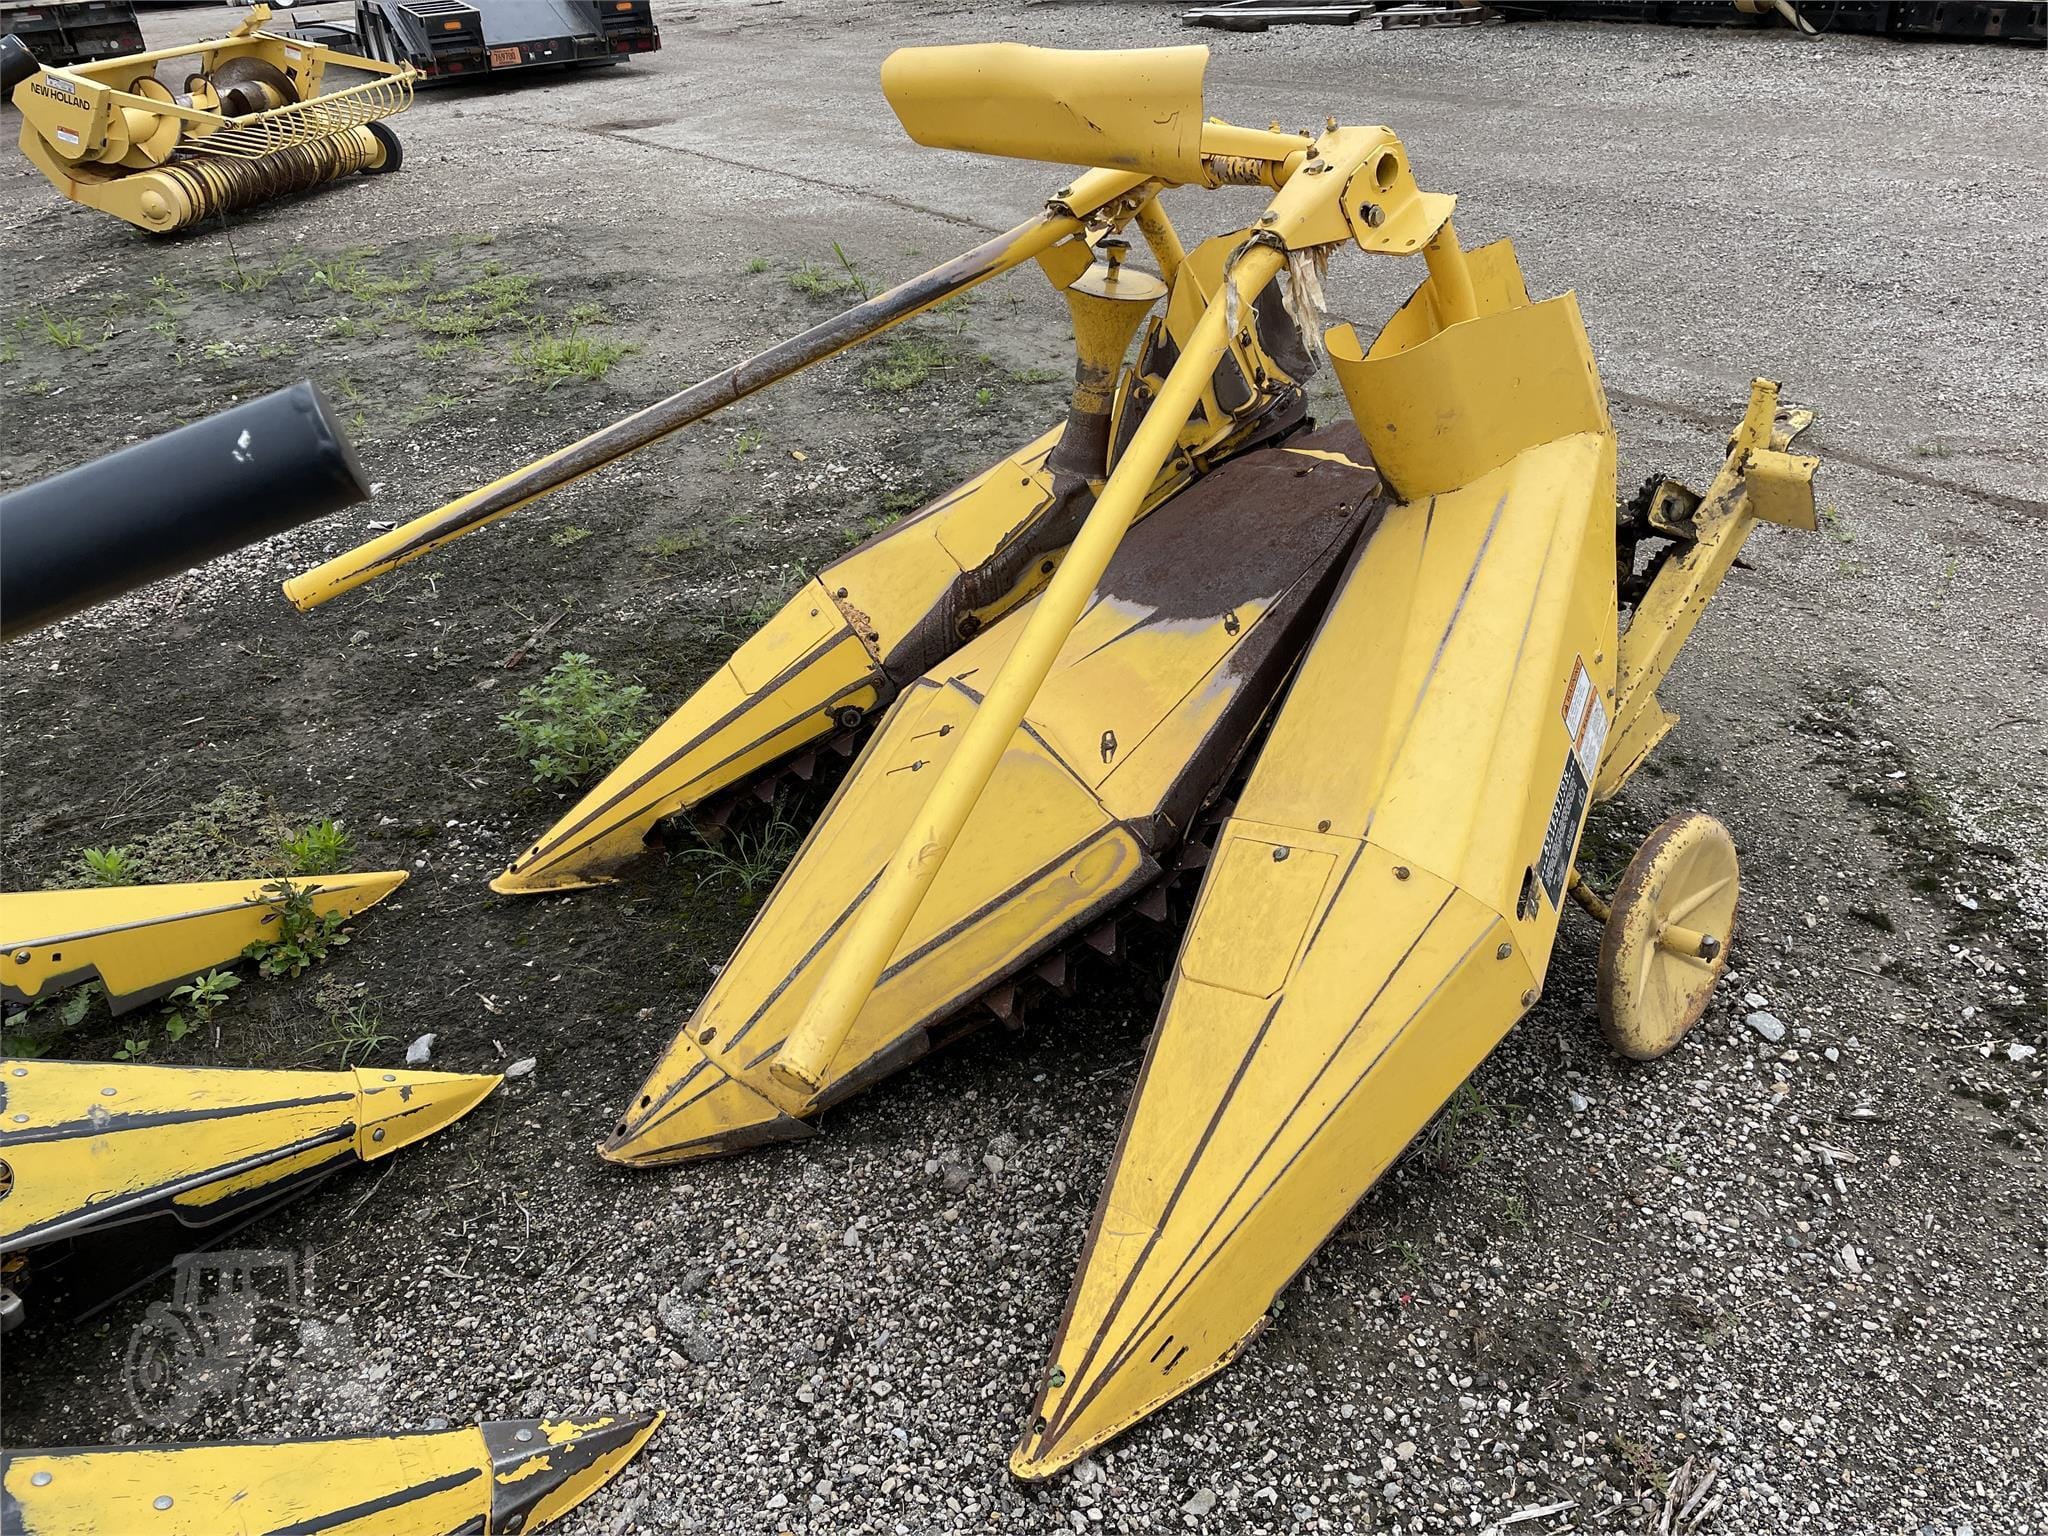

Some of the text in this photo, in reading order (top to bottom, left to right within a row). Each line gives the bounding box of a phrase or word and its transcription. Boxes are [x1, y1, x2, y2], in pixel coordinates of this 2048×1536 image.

[31, 83, 49, 97] NEW
[51, 90, 90, 110] HOLLAND
[1544, 770, 1569, 853] ATTENTION
